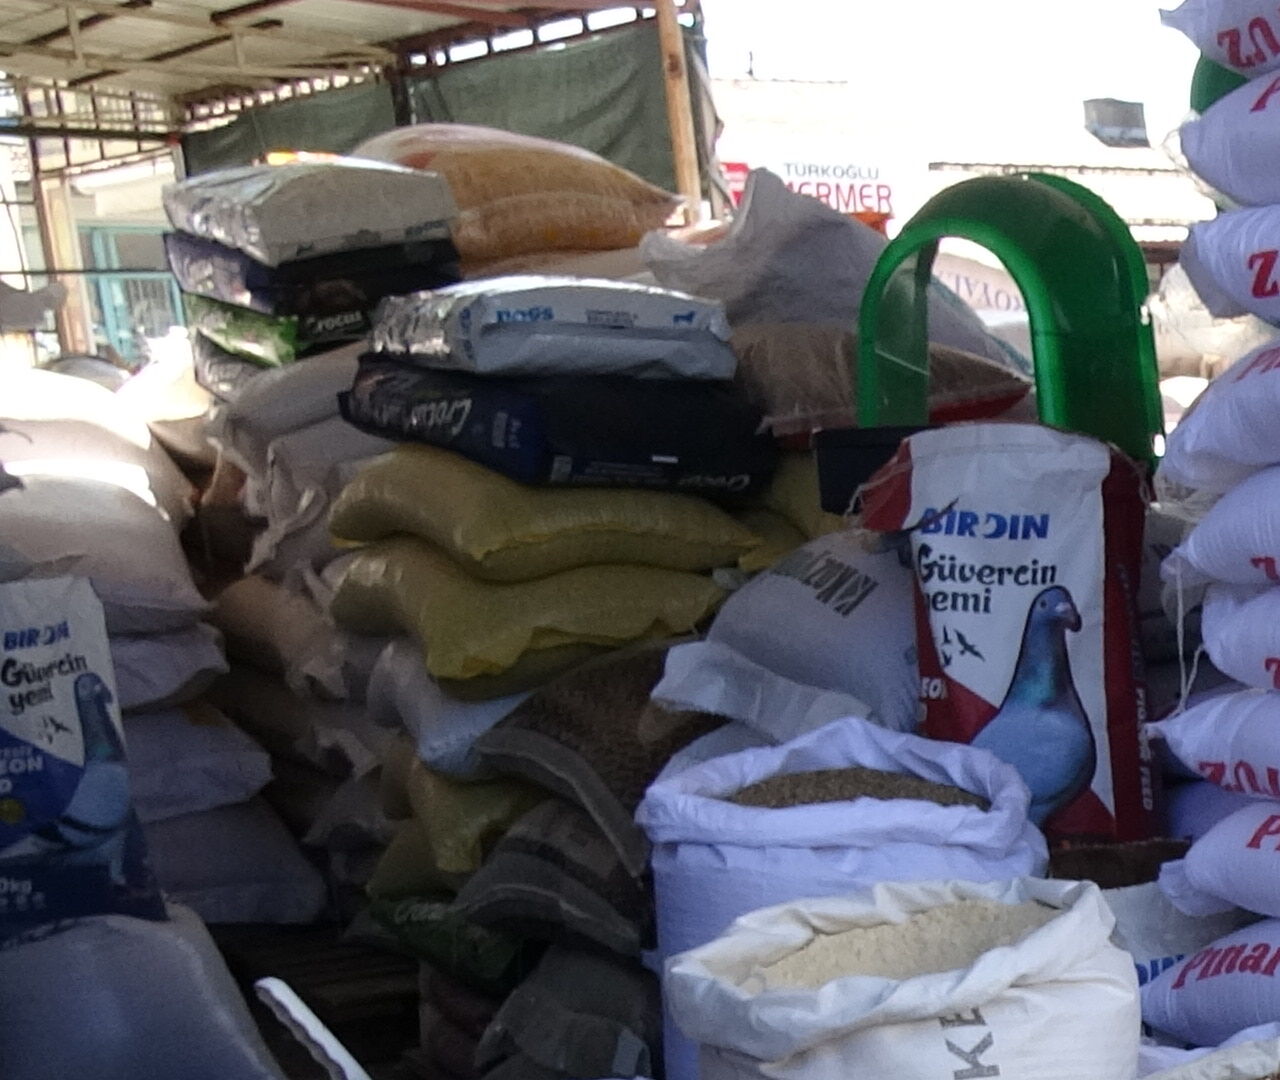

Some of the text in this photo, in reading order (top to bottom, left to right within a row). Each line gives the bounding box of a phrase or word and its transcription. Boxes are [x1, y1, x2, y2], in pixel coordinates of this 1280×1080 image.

[784, 162, 880, 180] TÜRKOĞLU
[785, 182, 893, 213] ERMER
[918, 543, 1059, 587] Güvercin
